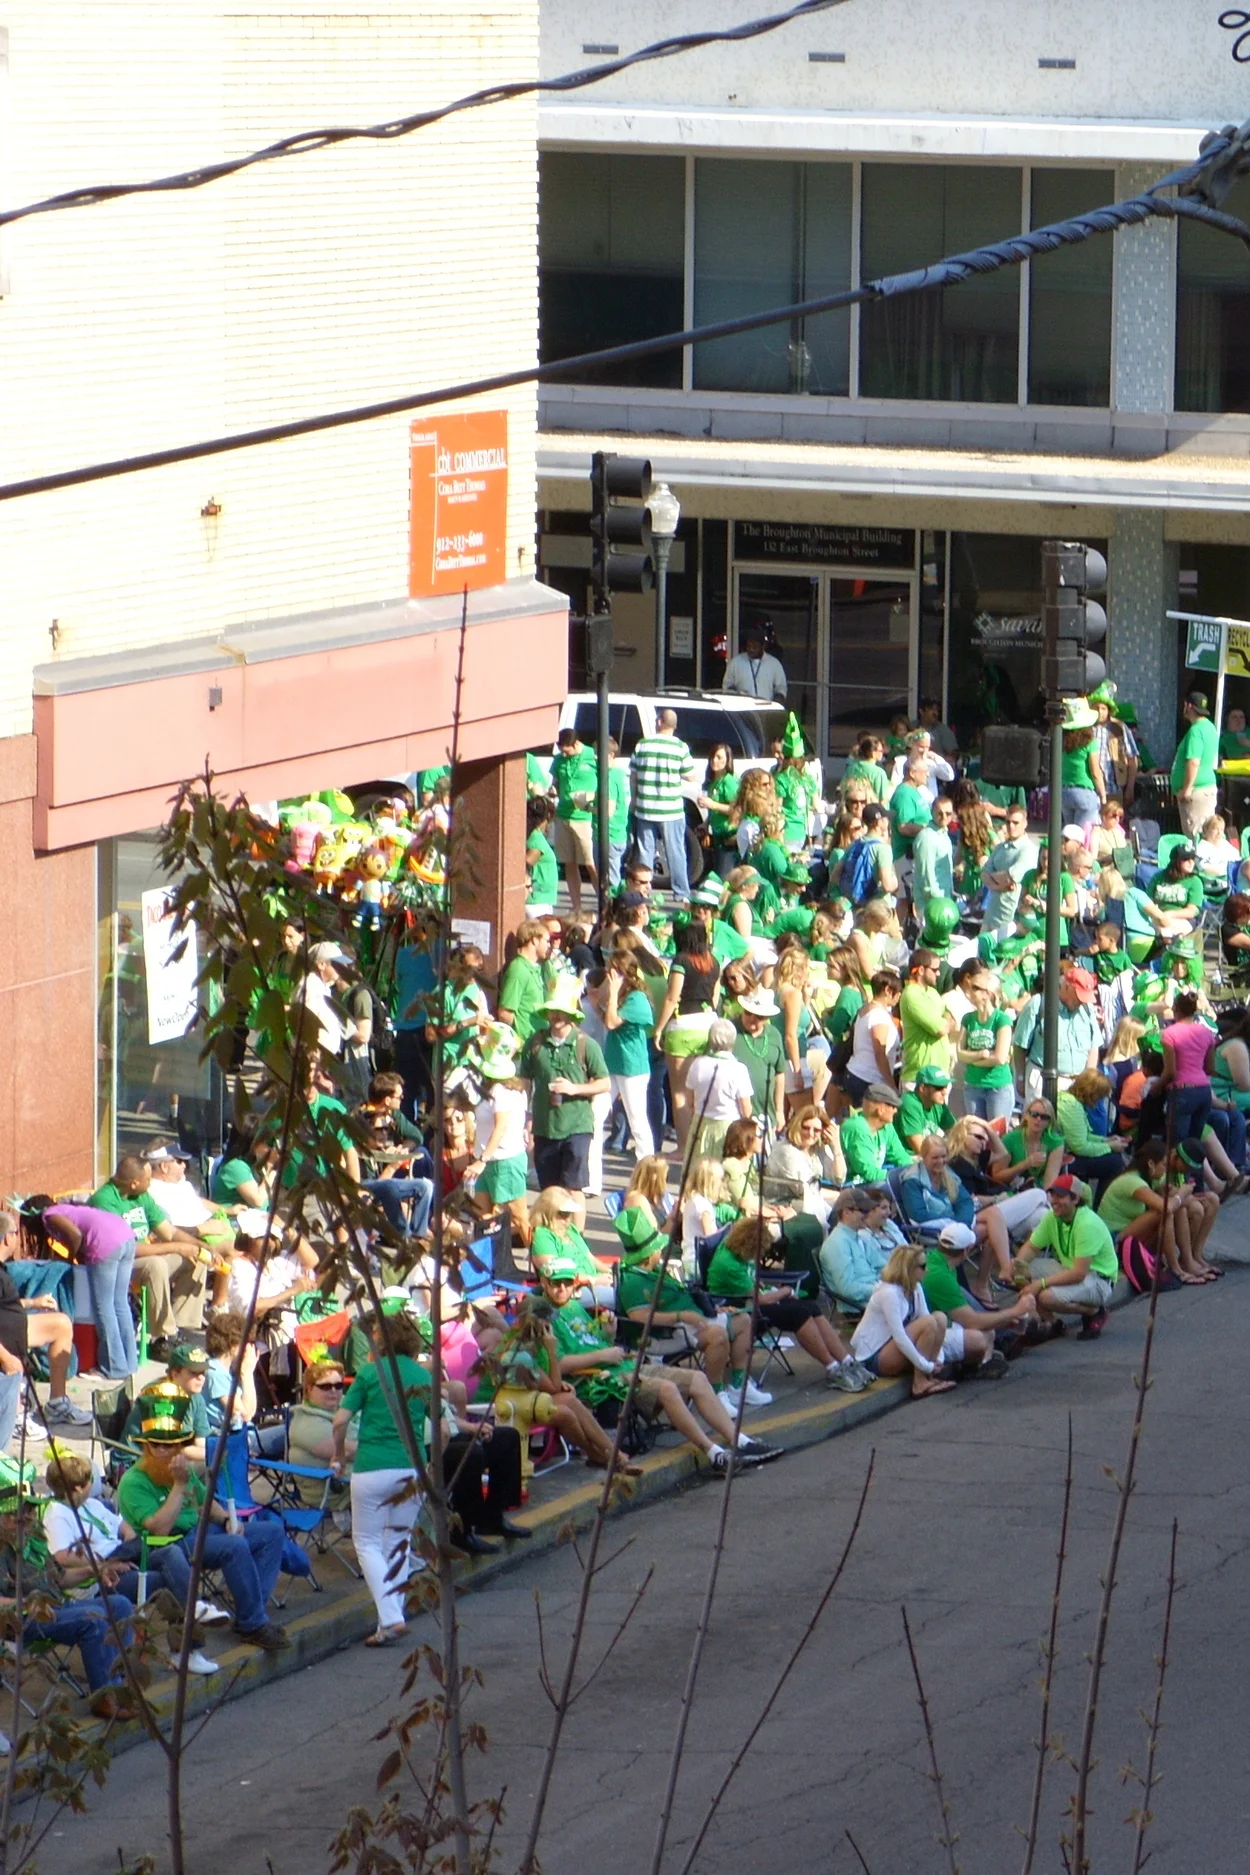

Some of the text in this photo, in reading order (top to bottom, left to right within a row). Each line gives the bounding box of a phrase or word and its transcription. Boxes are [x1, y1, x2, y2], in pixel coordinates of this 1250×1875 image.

[454, 447, 506, 472] COMMERCIAL
[742, 523, 902, 545] The Broughton Municipal Building
[779, 541, 798, 553] East
[802, 543, 849, 558] Broughton
[852, 546, 879, 558] Street
[1193, 622, 1220, 643] TRASH
